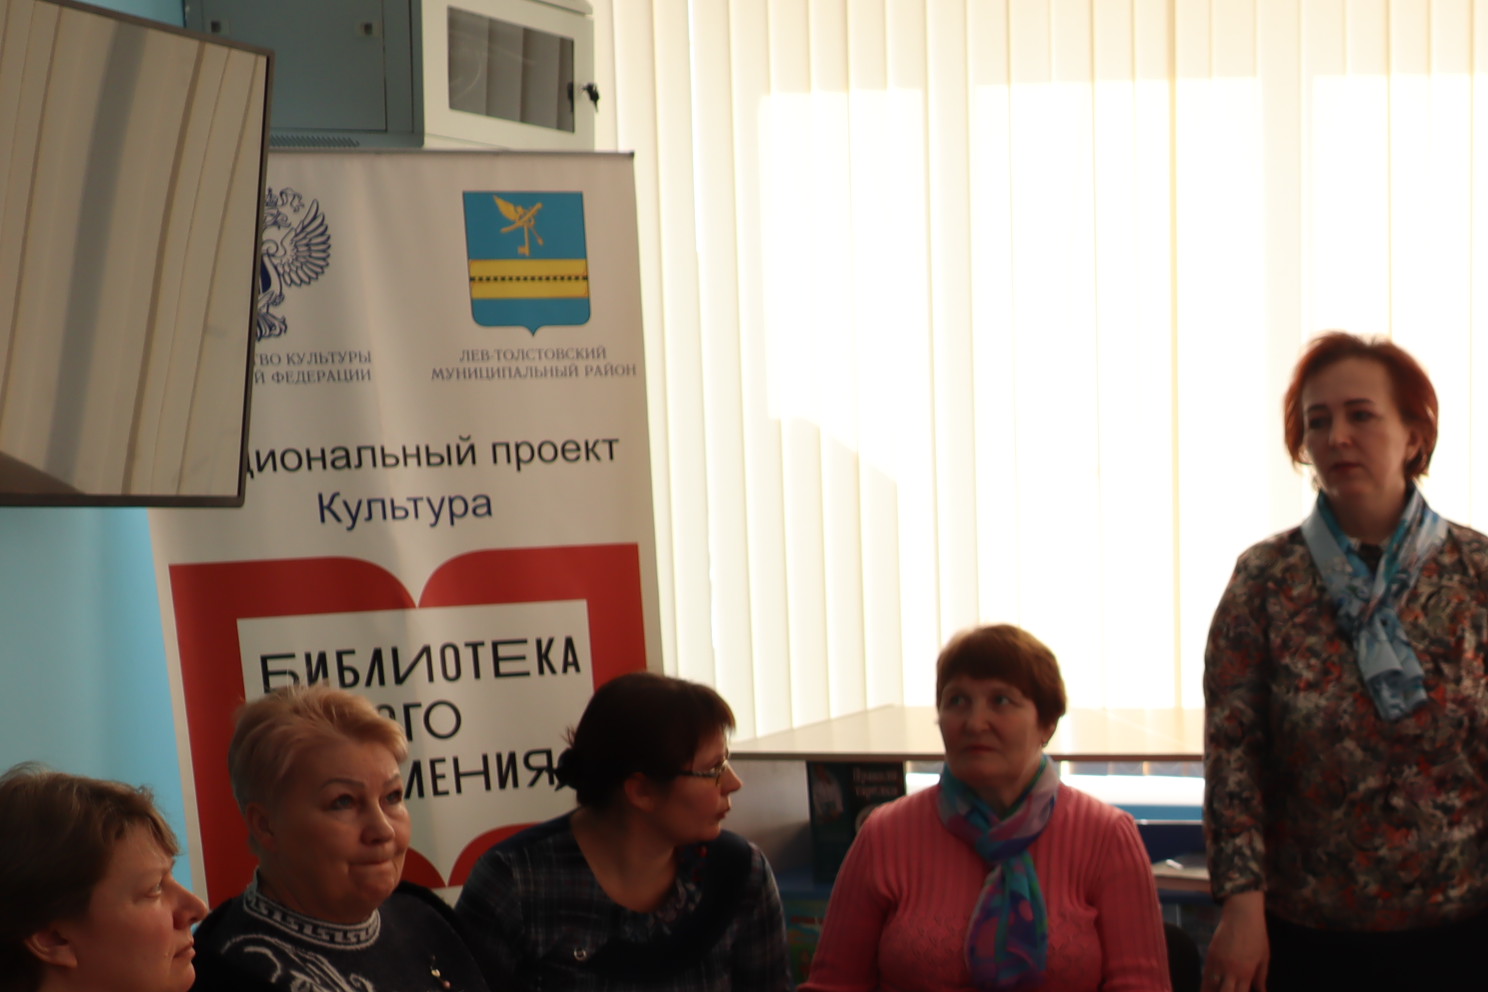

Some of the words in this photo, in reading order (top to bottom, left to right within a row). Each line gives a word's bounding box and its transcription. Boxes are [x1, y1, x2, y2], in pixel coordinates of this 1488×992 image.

[286, 350, 372, 366] КУЛЬТУРЫ
[459, 345, 607, 362] ЛЕВ-ТОЛСТОВСКИЙ
[271, 368, 372, 384] ФЕДЕРАЦИИ
[431, 363, 579, 381] МУНИЦИПАЛЬНЫЙ
[584, 362, 637, 377] РАЙОН
[491, 438, 620, 473] проект
[317, 490, 493, 531] Культура
[260, 636, 582, 693] БИБЛИОТЕКА
[403, 748, 556, 800] ЛЕНИЯ
